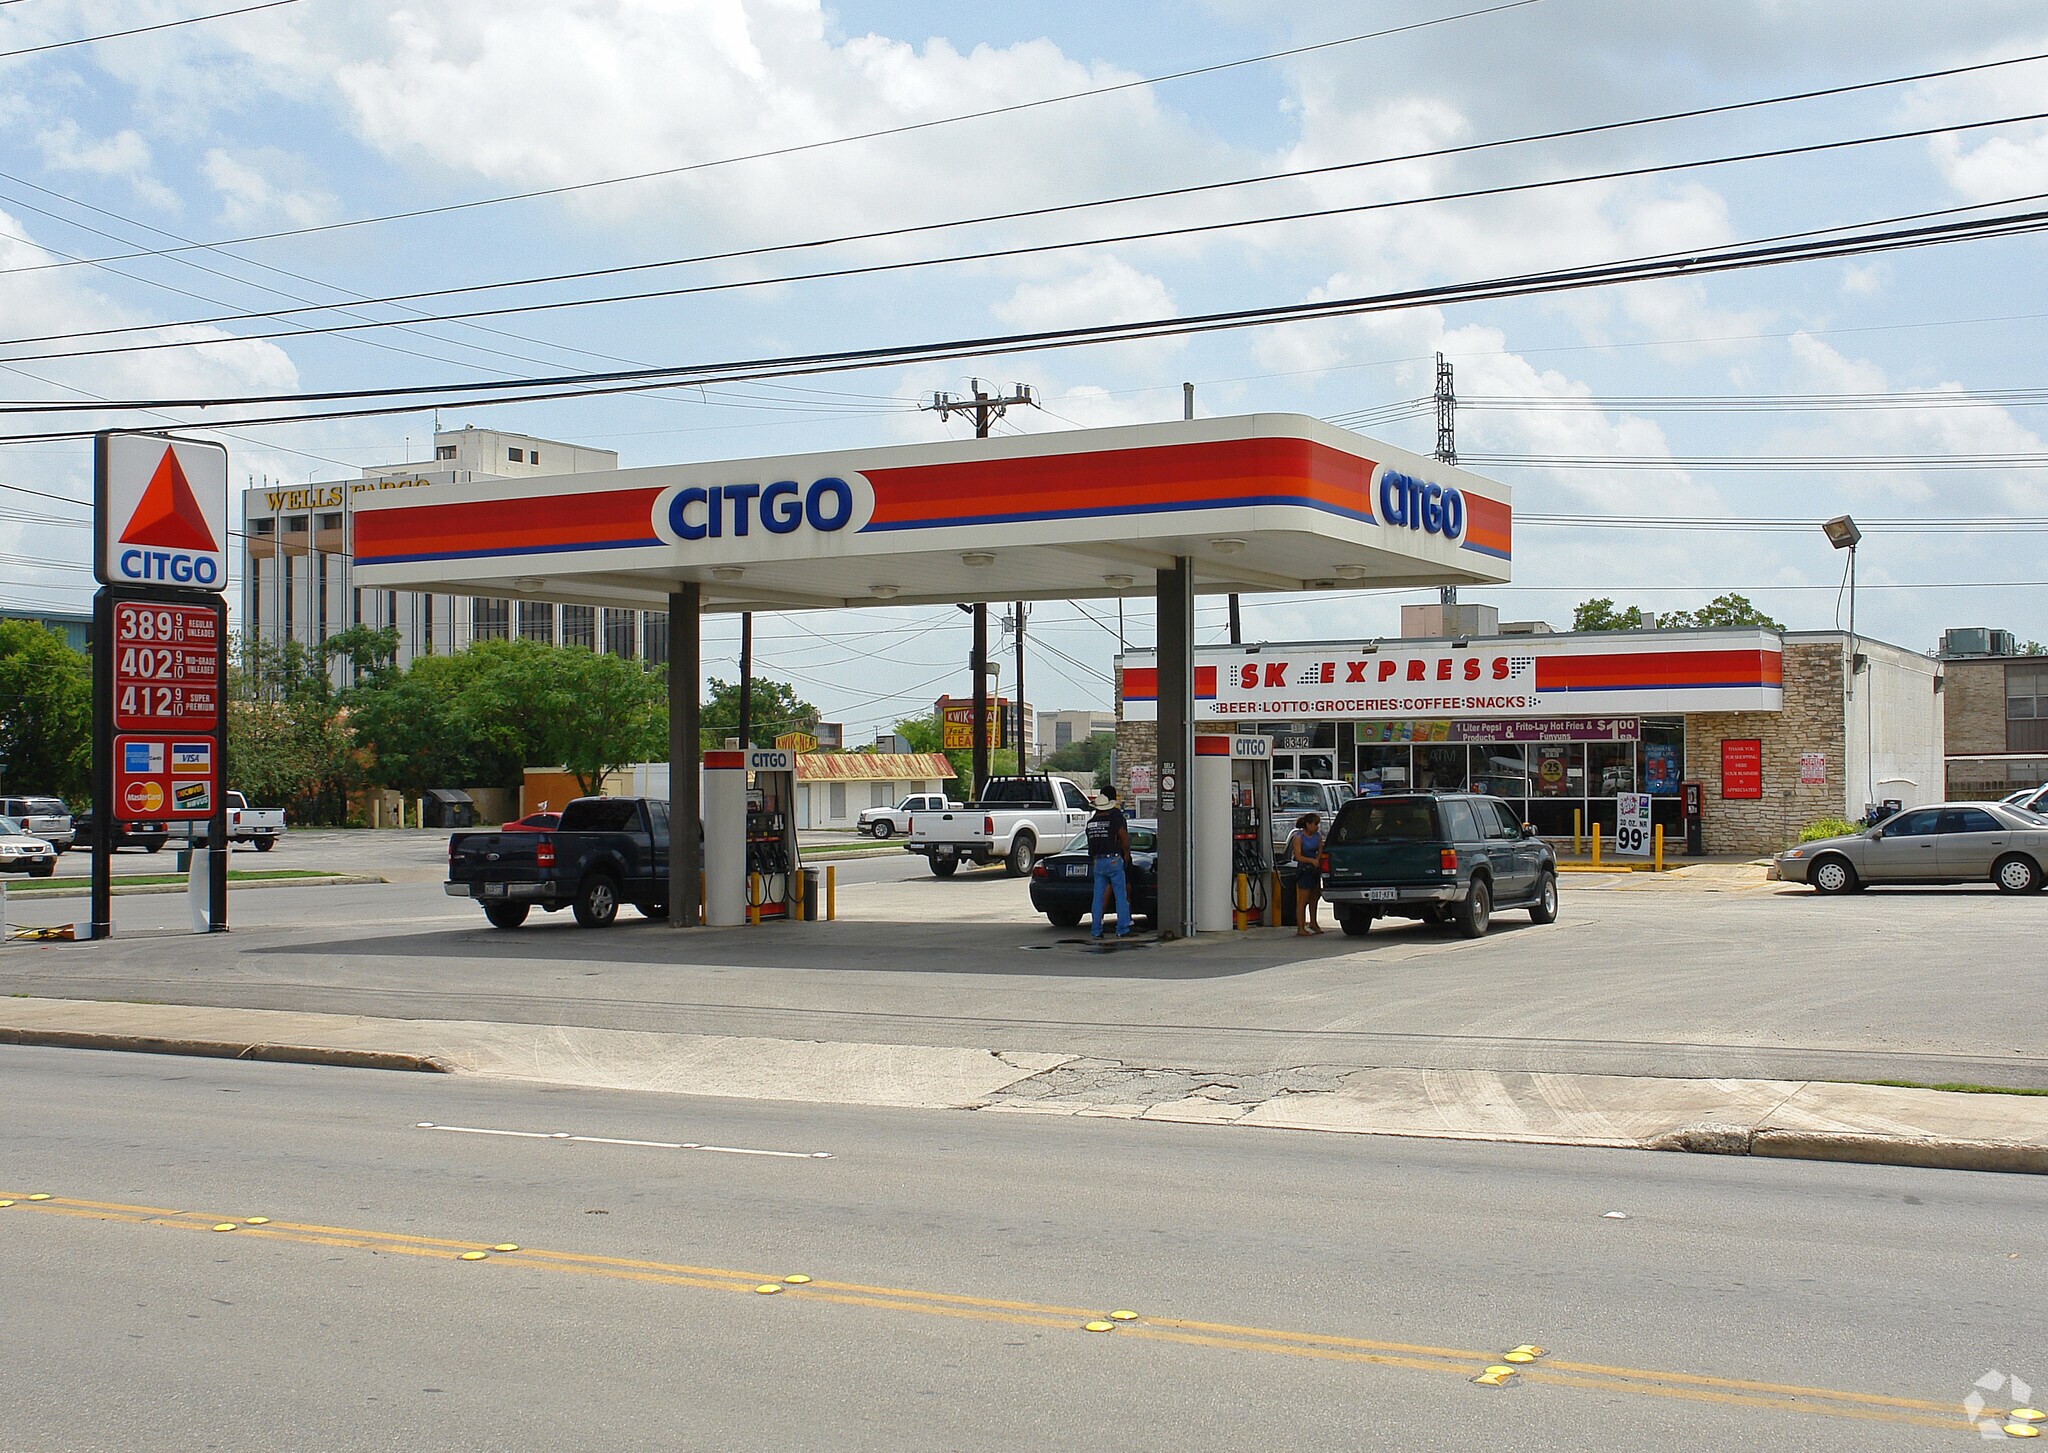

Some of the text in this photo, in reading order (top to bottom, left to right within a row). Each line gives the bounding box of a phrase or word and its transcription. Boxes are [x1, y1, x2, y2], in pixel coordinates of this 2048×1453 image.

[264, 487, 343, 511] WELLS
[1380, 470, 1462, 539] CITGO
[669, 478, 852, 540] CITGO
[121, 550, 217, 583] CITGO
[121, 610, 172, 640] 389
[188, 620, 214, 629] REGULAR
[187, 629, 216, 638] UNLEADED
[121, 648, 172, 678] 402
[187, 665, 215, 675] UNLEADED
[1241, 657, 1509, 689] SK EXPRESS
[121, 686, 172, 716] 412
[190, 694, 211, 703] SUPER
[1219, 696, 1525, 713] BEER LOTTO GROCERIES COFFEE SNACKS
[186, 702, 215, 712] PREMIUM
[947, 710, 969, 723] KWIK
[1462, 723, 1480, 732] Liter
[1481, 722, 1502, 734] Pepsi
[1515, 721, 1593, 733] Frito-Lay Hot Fries &
[1236, 739, 1266, 755] CITGO
[1285, 737, 1309, 748] 8342
[182, 754, 200, 762] VISA
[752, 753, 787, 768] CITGO
